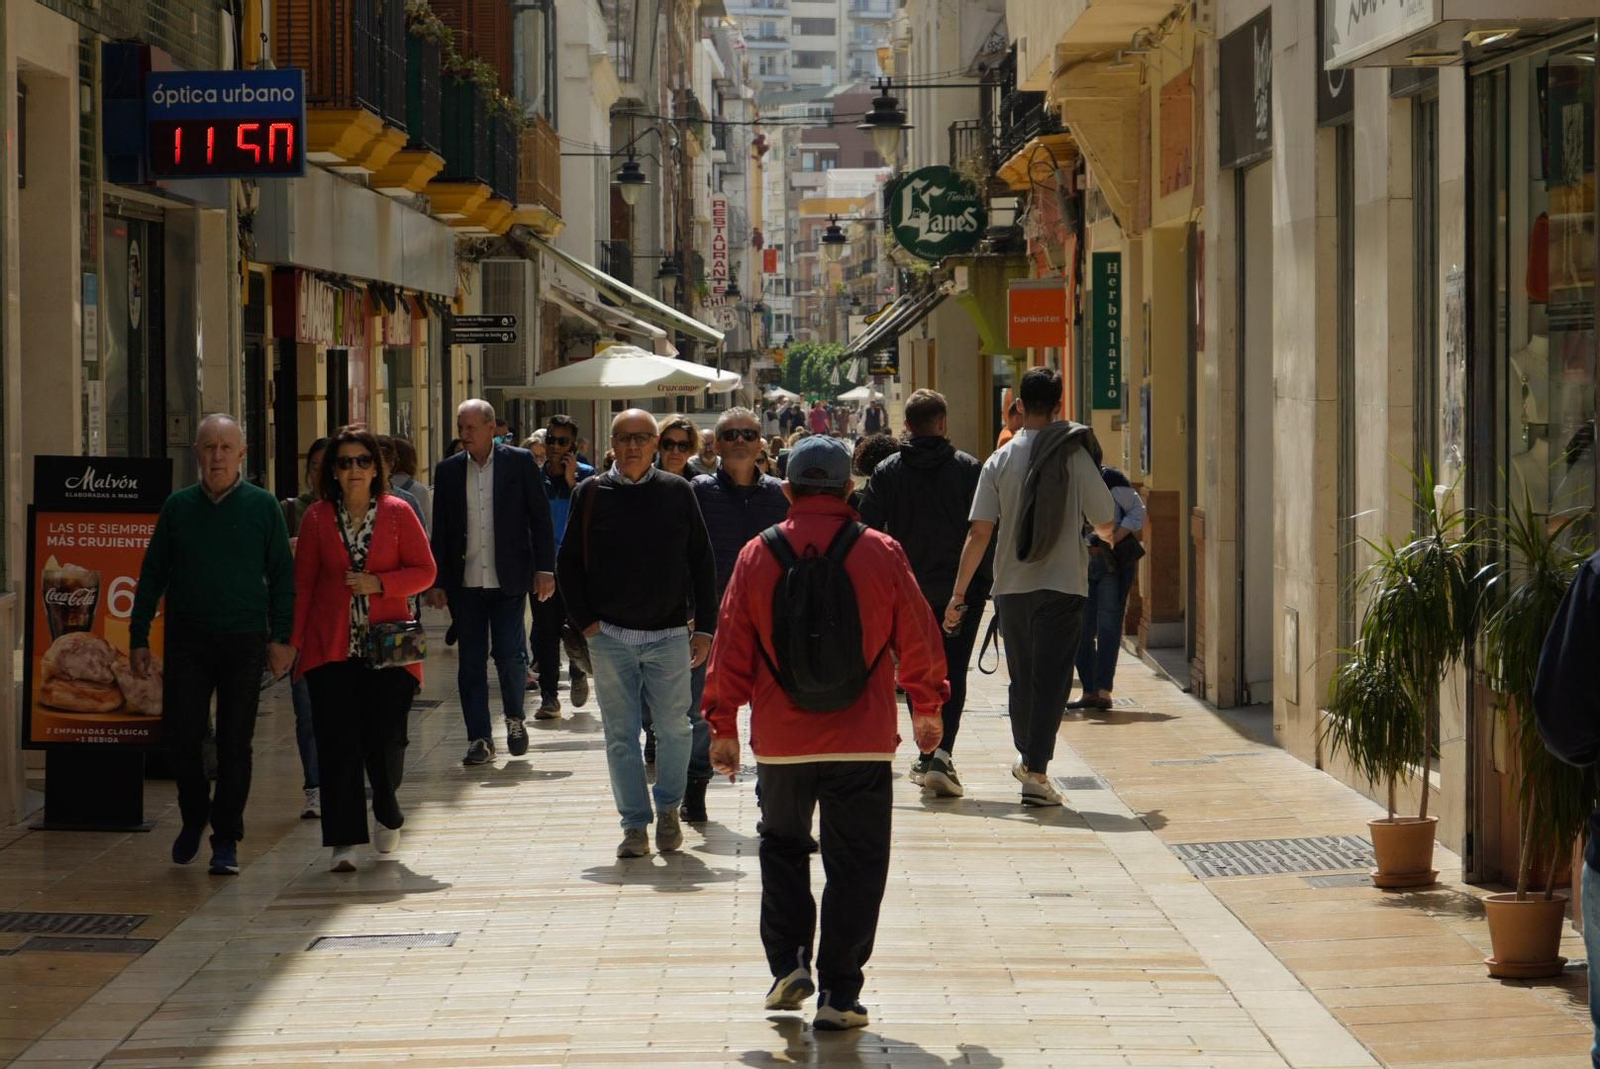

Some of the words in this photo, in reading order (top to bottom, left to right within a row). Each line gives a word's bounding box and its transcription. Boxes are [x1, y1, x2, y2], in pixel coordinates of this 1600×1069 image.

[152, 83, 217, 108] óptica
[222, 83, 295, 103] urbano
[712, 200, 726, 294] RESTAURANTE
[1013, 315, 1061, 324] bankinter
[1106, 262, 1118, 399] Herbolario
[65, 465, 139, 492] Malvón
[49, 523, 74, 533] LAS
[78, 523, 96, 534] DE
[99, 523, 156, 535] SIEMPRE
[46, 534, 75, 547] MÁS
[78, 536, 151, 548] CRUJIENTE
[54, 728, 106, 736] EMPANADAS
[107, 728, 149, 736] CLÁSICAS
[87, 736, 119, 744] BEBIDA
